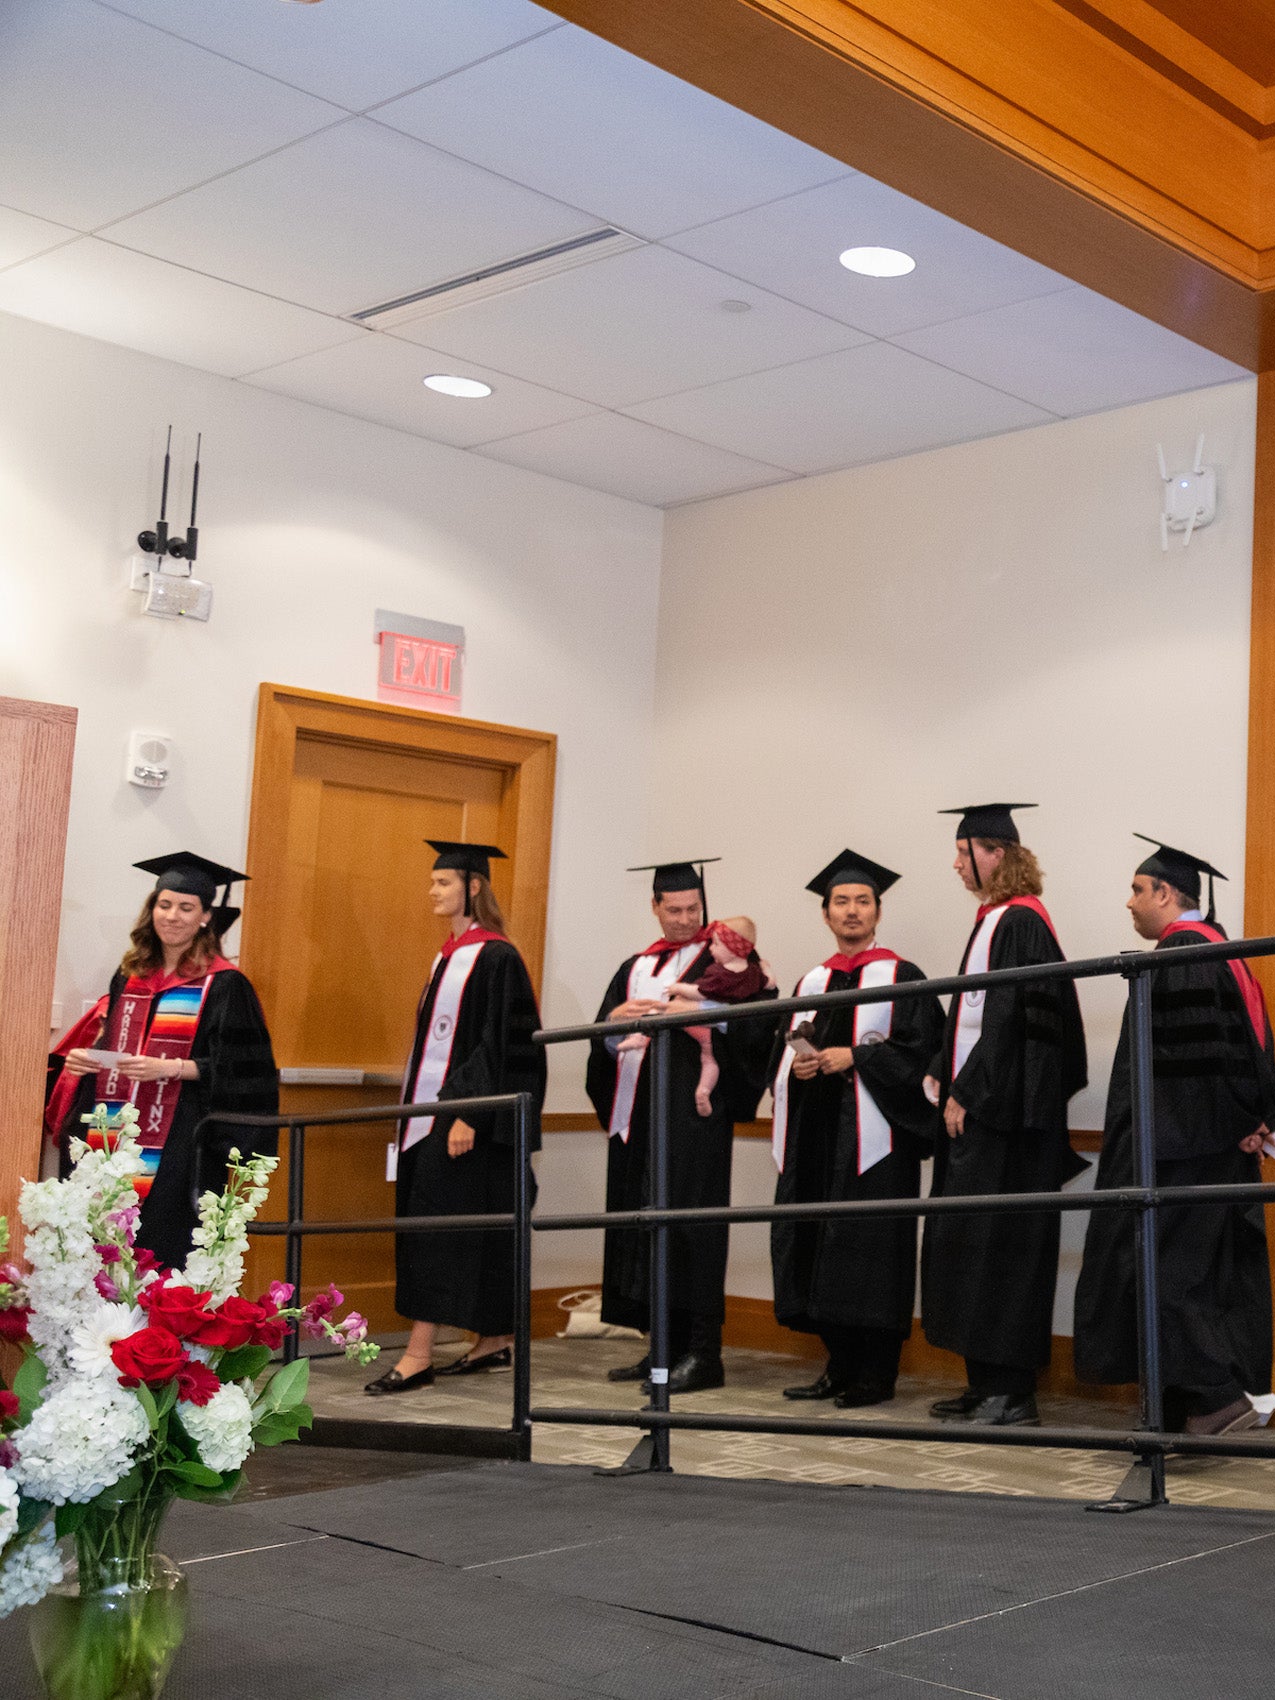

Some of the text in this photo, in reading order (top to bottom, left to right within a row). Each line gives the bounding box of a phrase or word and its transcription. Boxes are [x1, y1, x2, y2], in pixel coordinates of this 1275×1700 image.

[393, 638, 457, 692] EXIT
[106, 1001, 136, 1095] HARVRD
[147, 1053, 170, 1133] TINX
